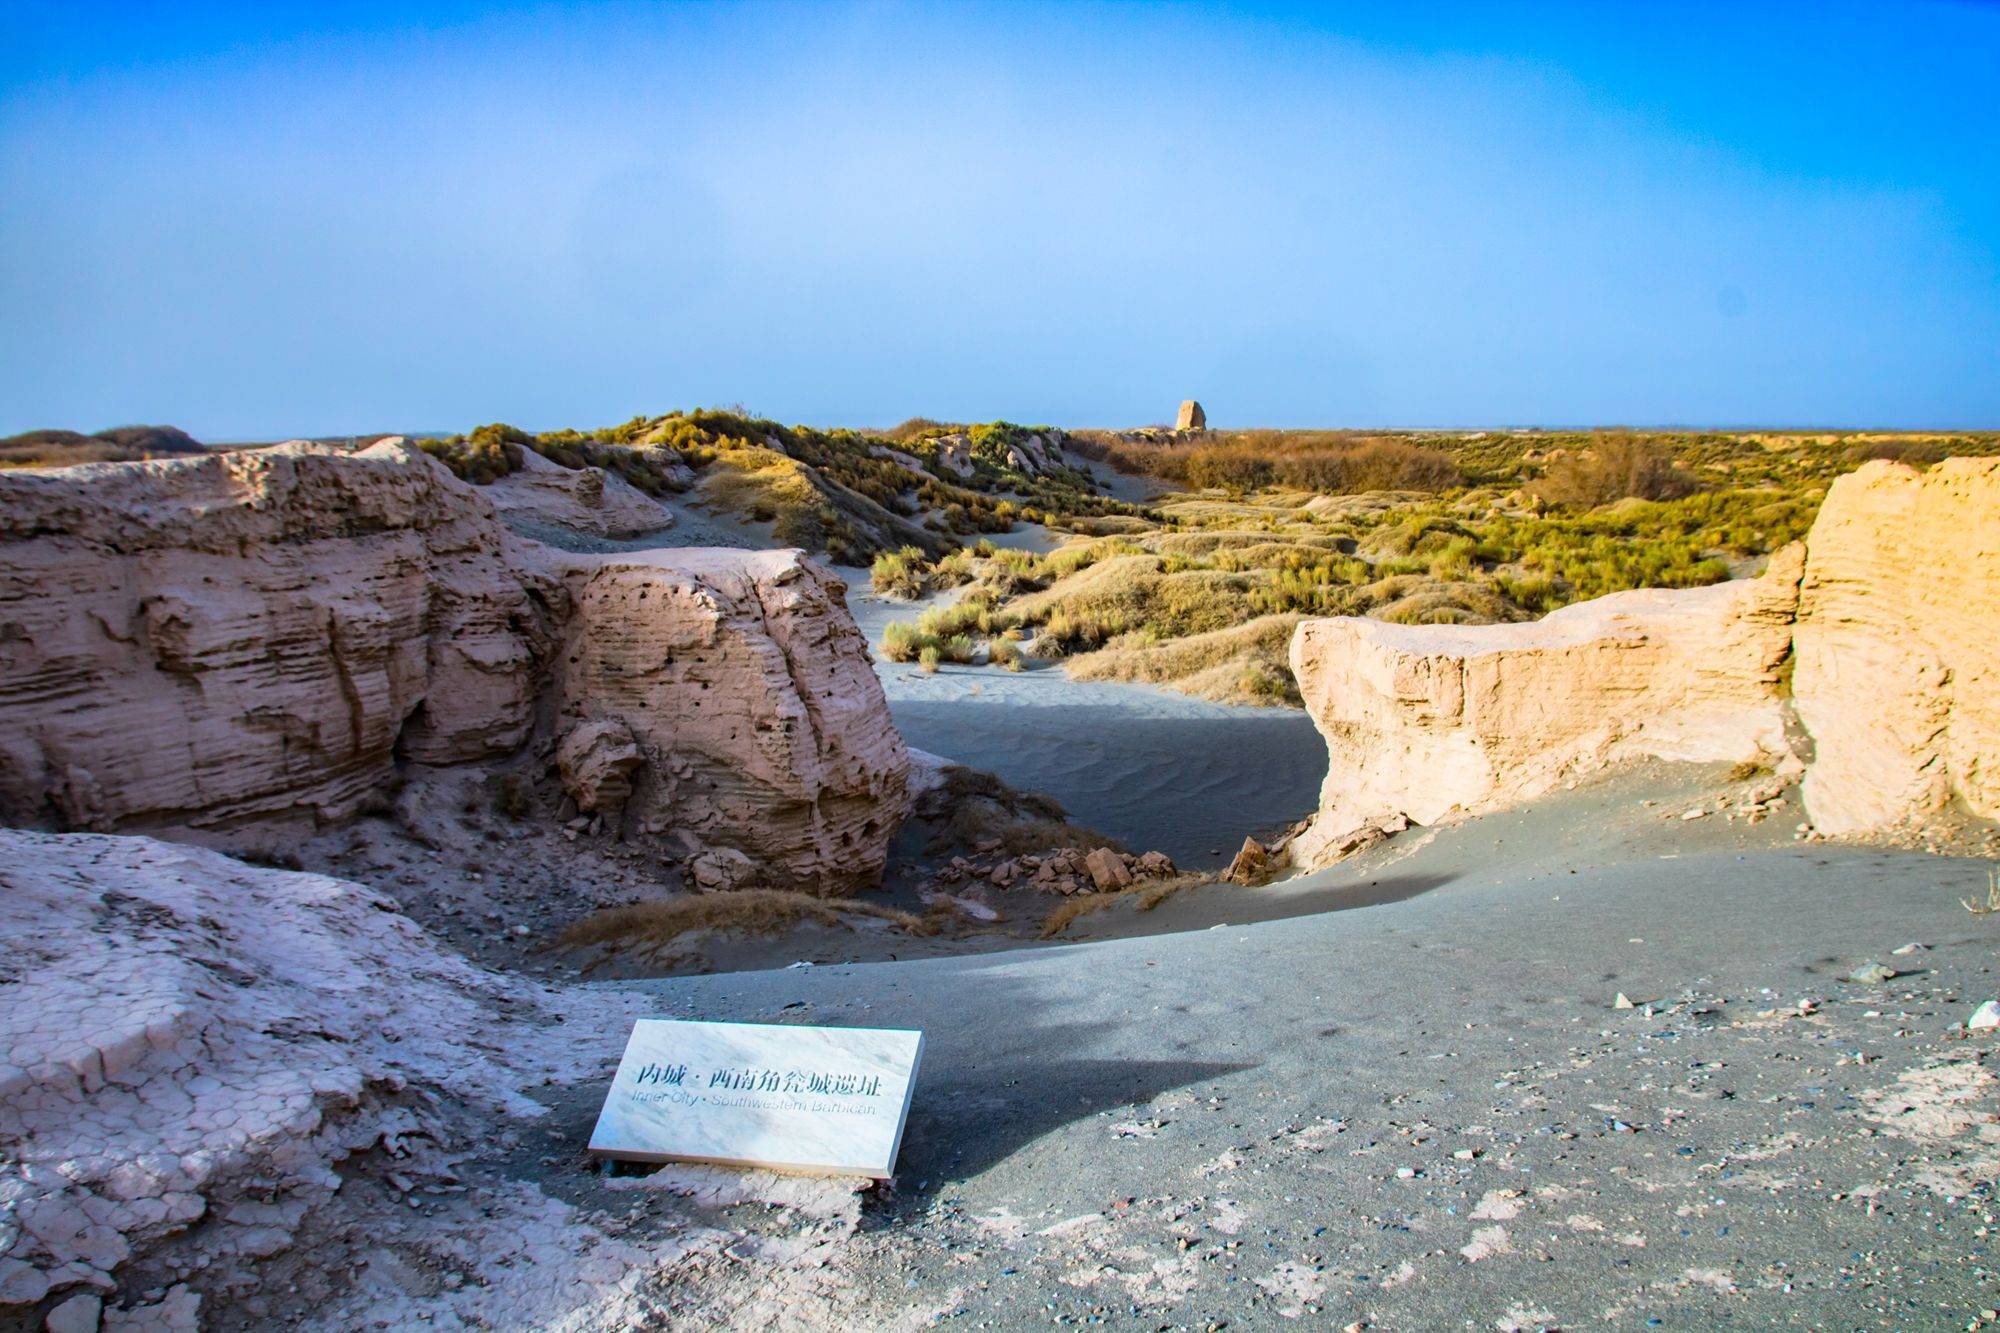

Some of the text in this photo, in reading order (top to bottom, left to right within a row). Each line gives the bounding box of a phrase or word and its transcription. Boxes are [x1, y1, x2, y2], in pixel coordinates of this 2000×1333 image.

[632, 1090, 876, 1115] Inner City Southwestern Barbican
